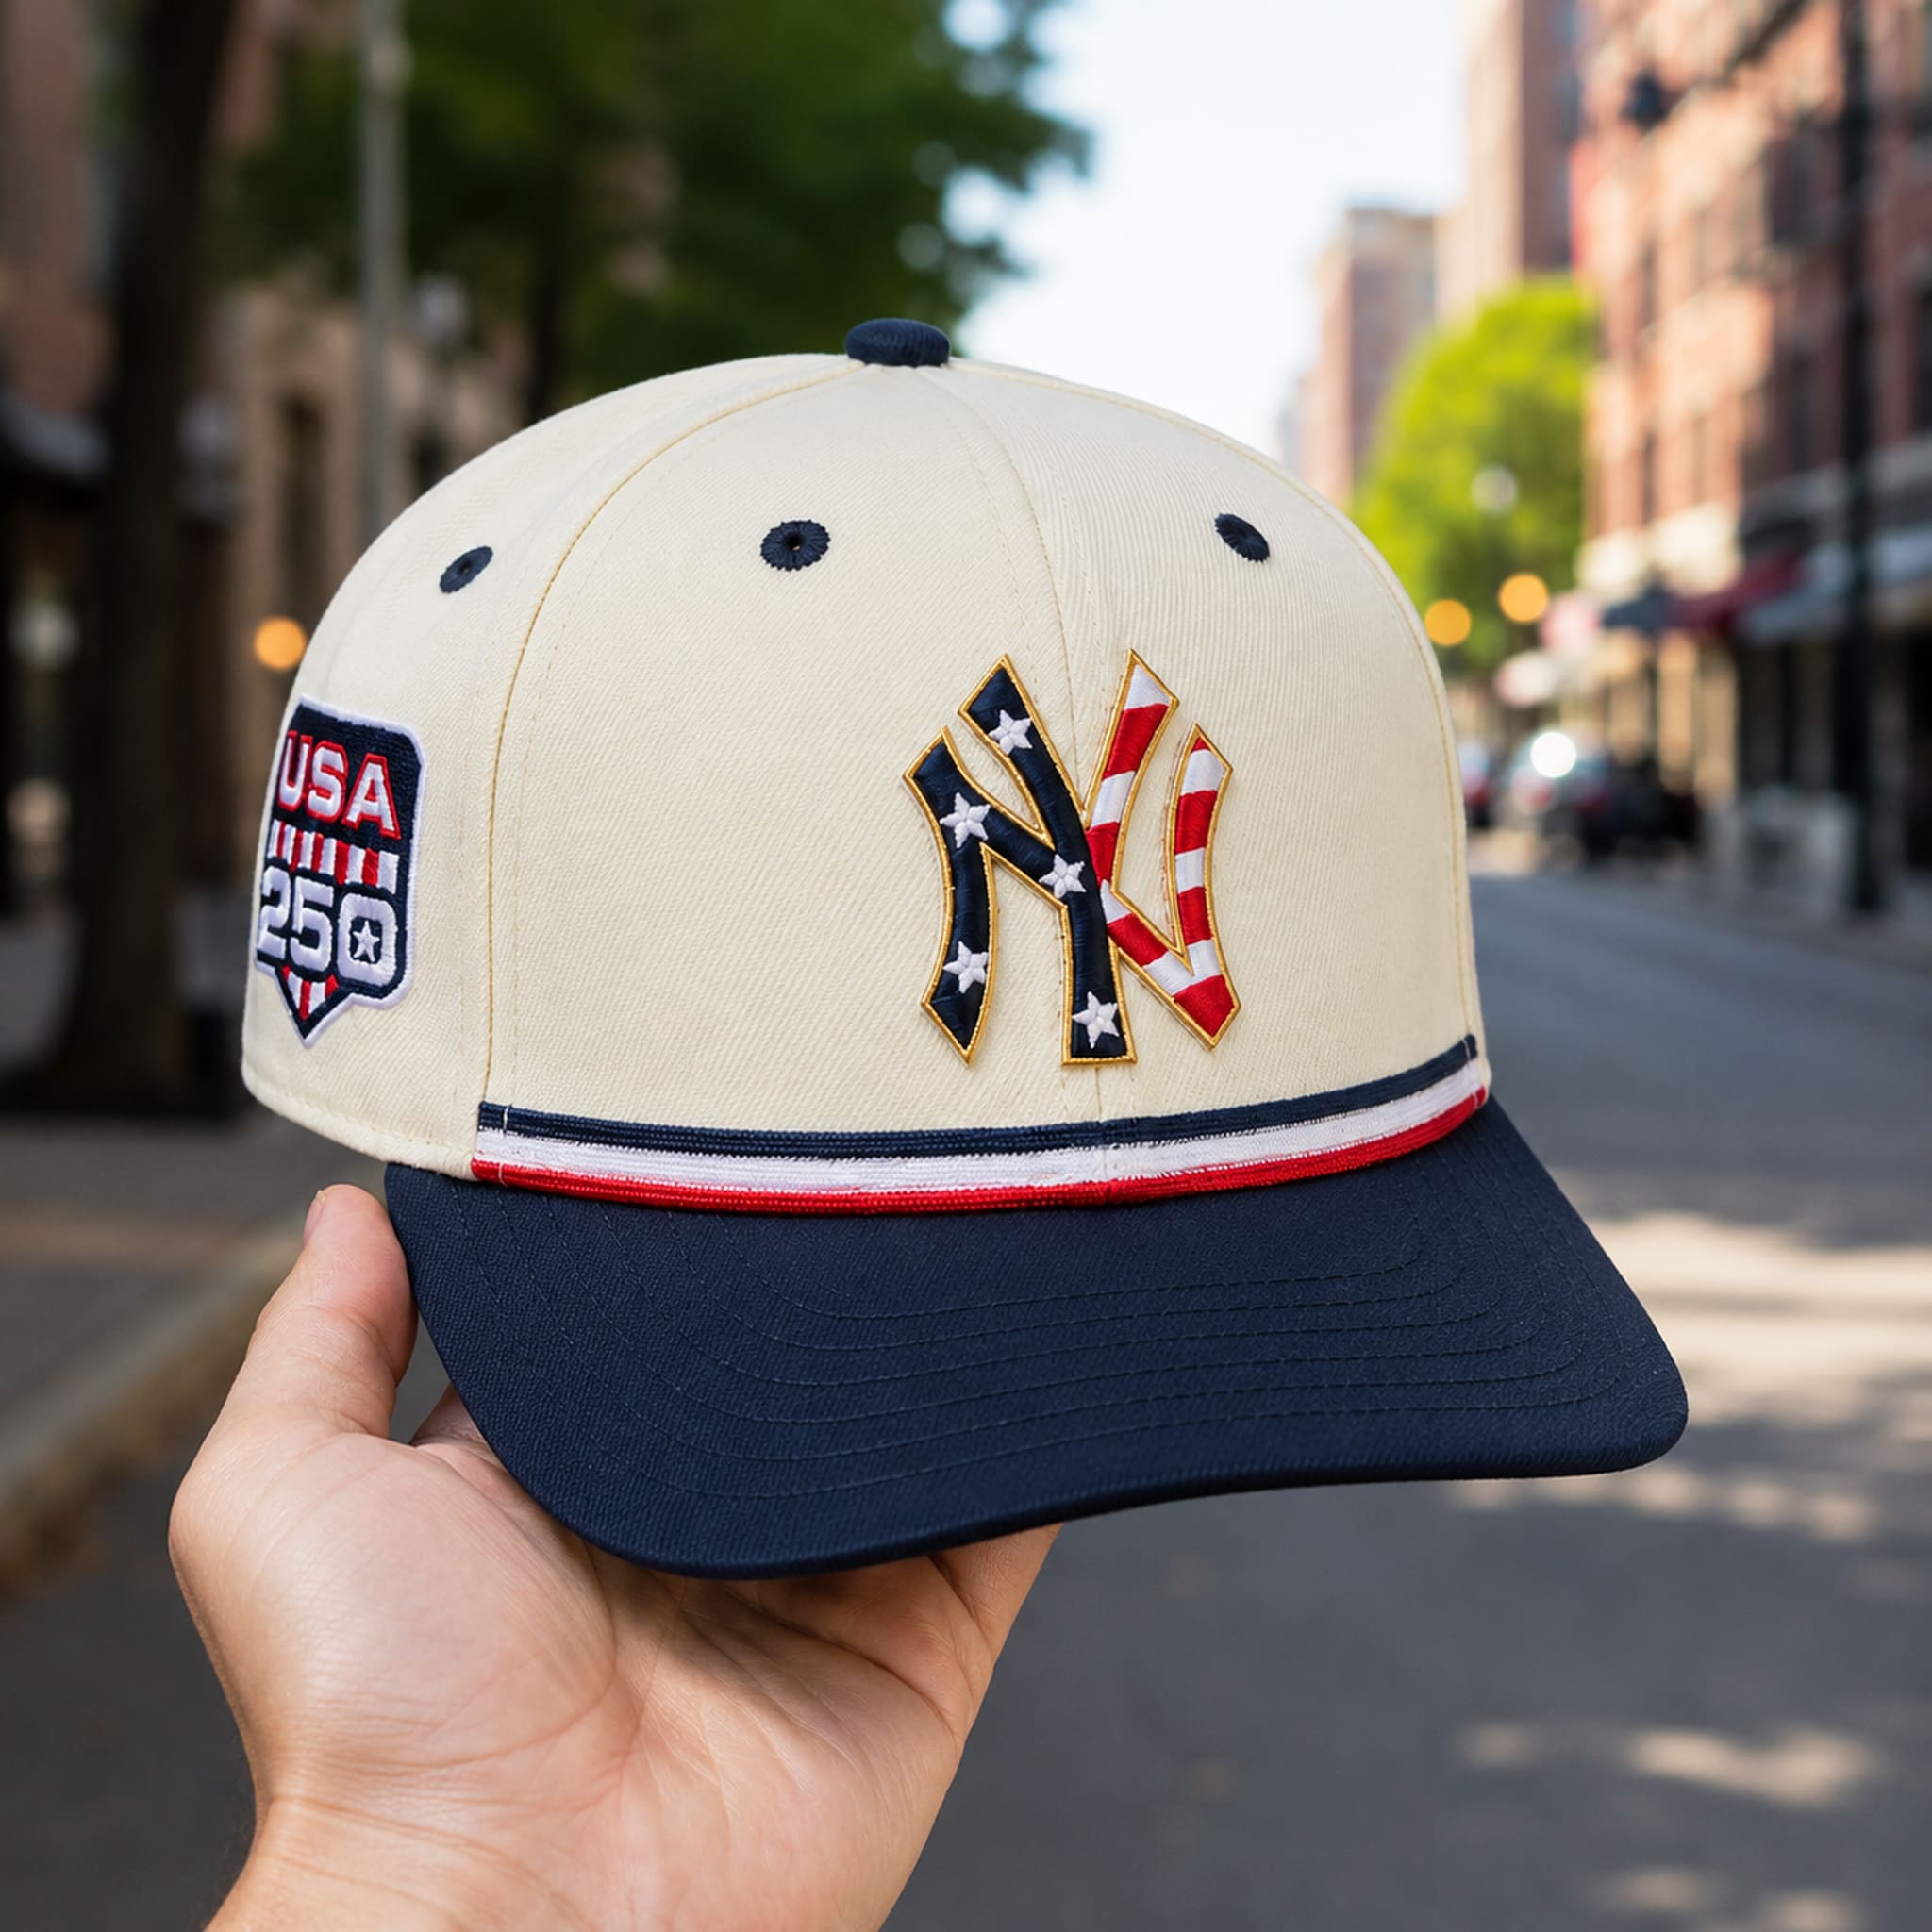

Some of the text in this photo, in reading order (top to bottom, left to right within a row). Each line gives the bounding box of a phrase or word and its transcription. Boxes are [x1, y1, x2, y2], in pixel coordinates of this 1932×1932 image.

[278, 730, 401, 840] USA
[902, 648, 1241, 1068] NY
[257, 865, 397, 987] 250
